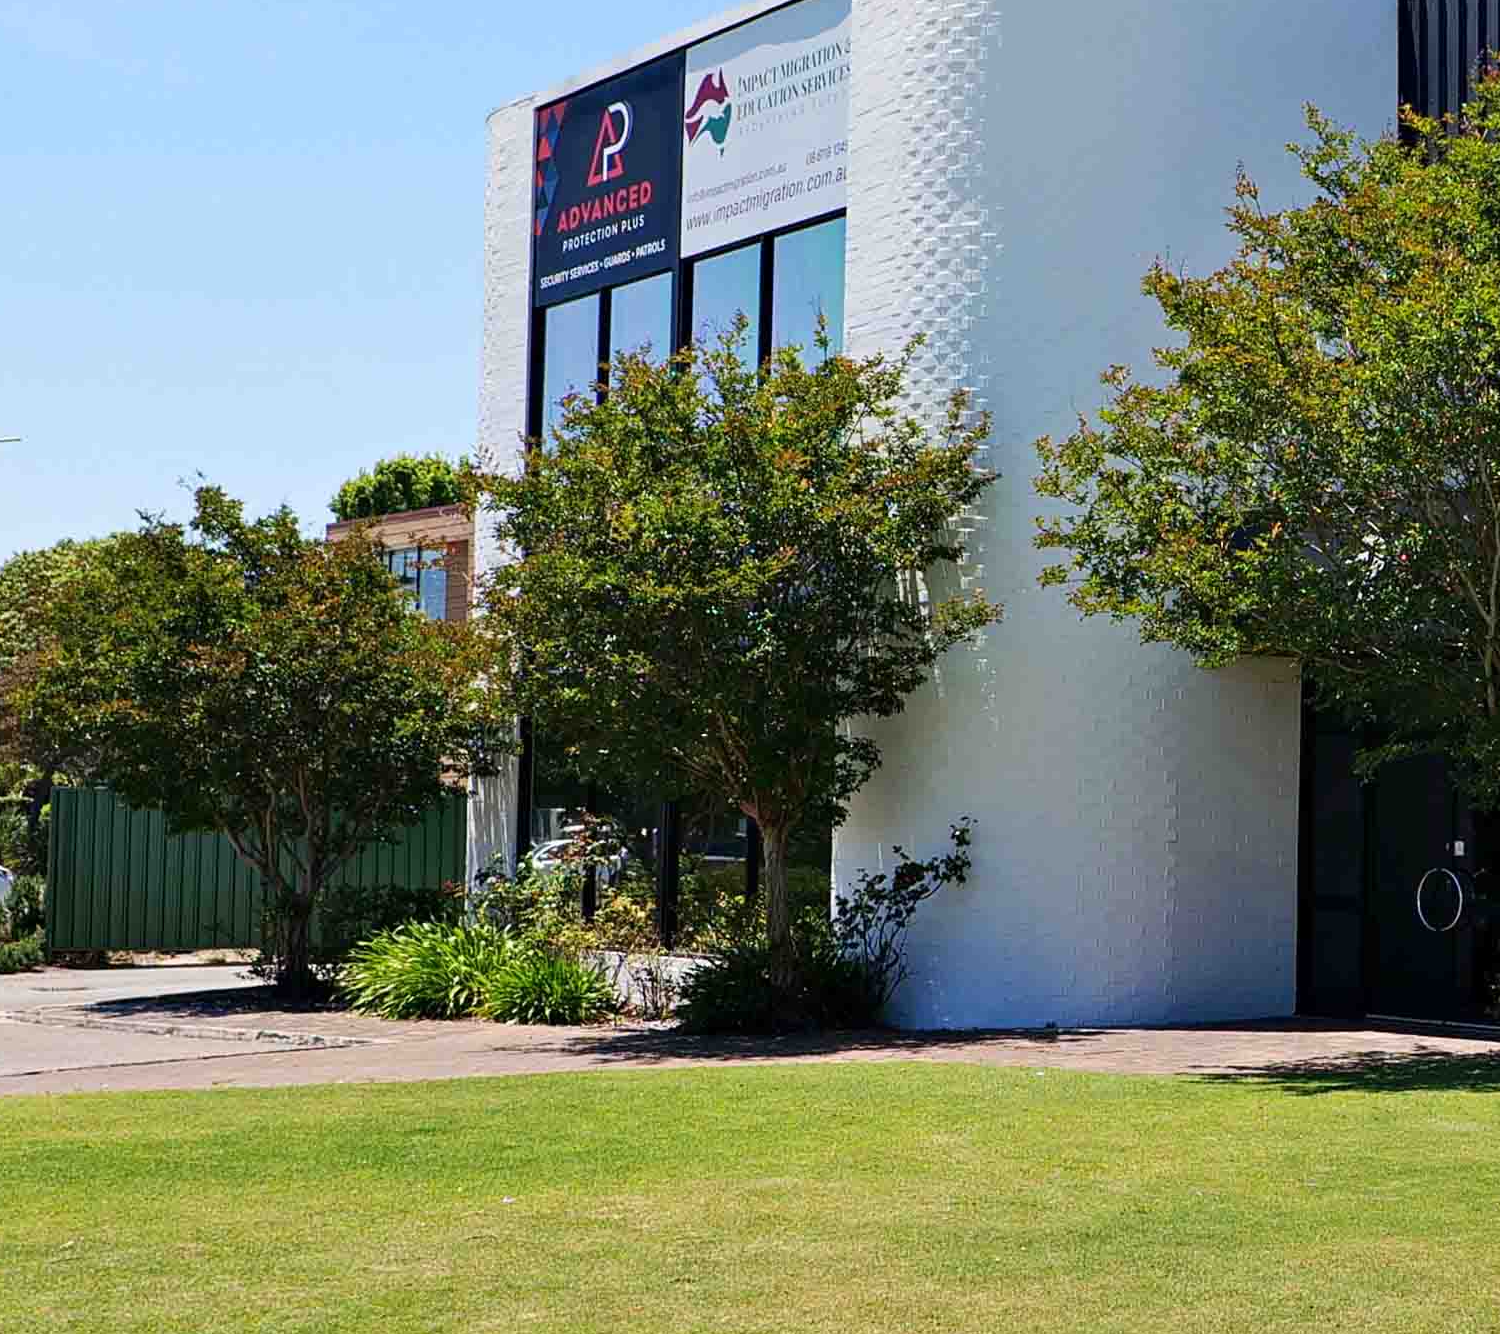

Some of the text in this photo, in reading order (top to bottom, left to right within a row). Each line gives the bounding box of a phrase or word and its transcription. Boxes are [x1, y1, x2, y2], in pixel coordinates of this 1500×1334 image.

[736, 85, 799, 122] EDUCATION
[801, 61, 851, 96] SERVICES
[737, 67, 778, 98] IMPACT
[779, 41, 842, 79] MIGRATION
[557, 180, 652, 233] ADVANCED
[562, 214, 645, 252] PROTECTION PLUS
[540, 238, 666, 289] SECURITY SERVICES GUARDS PATROLS
